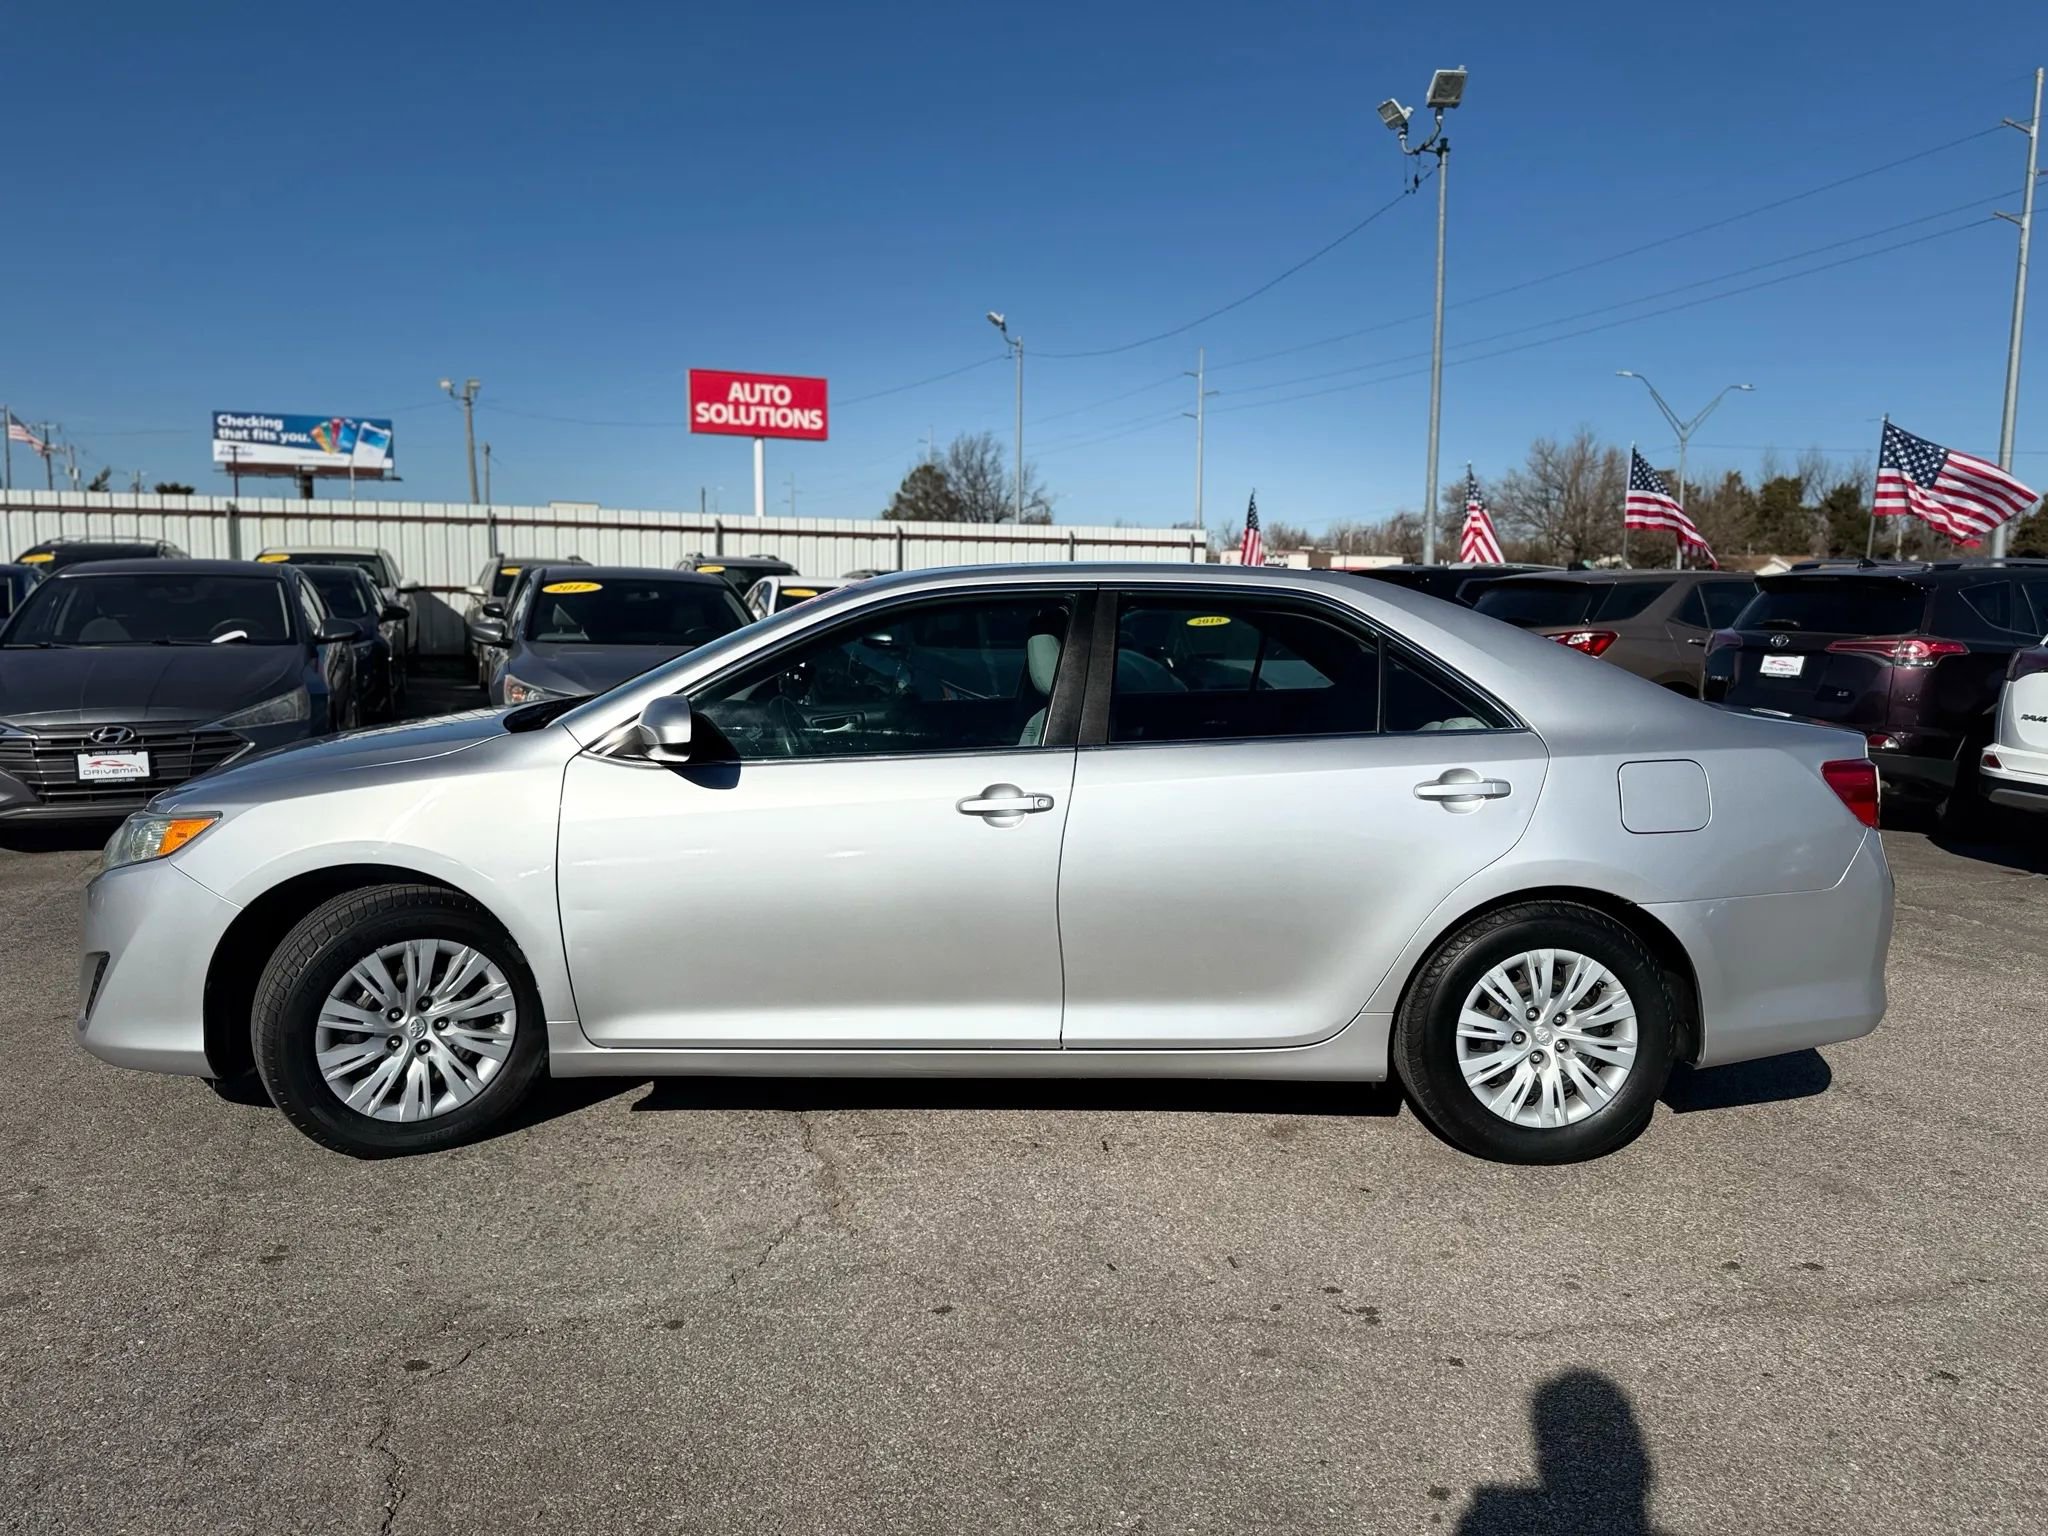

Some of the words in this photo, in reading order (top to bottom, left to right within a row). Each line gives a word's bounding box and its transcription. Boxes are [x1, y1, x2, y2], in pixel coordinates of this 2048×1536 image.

[727, 381, 792, 406] AUTO
[217, 414, 283, 431] Checking
[695, 402, 824, 430] SOLUTIONS
[217, 428, 245, 440] that
[252, 429, 277, 441] fits
[280, 433, 311, 444] you.
[83, 766, 145, 776] DRIVEMAX
